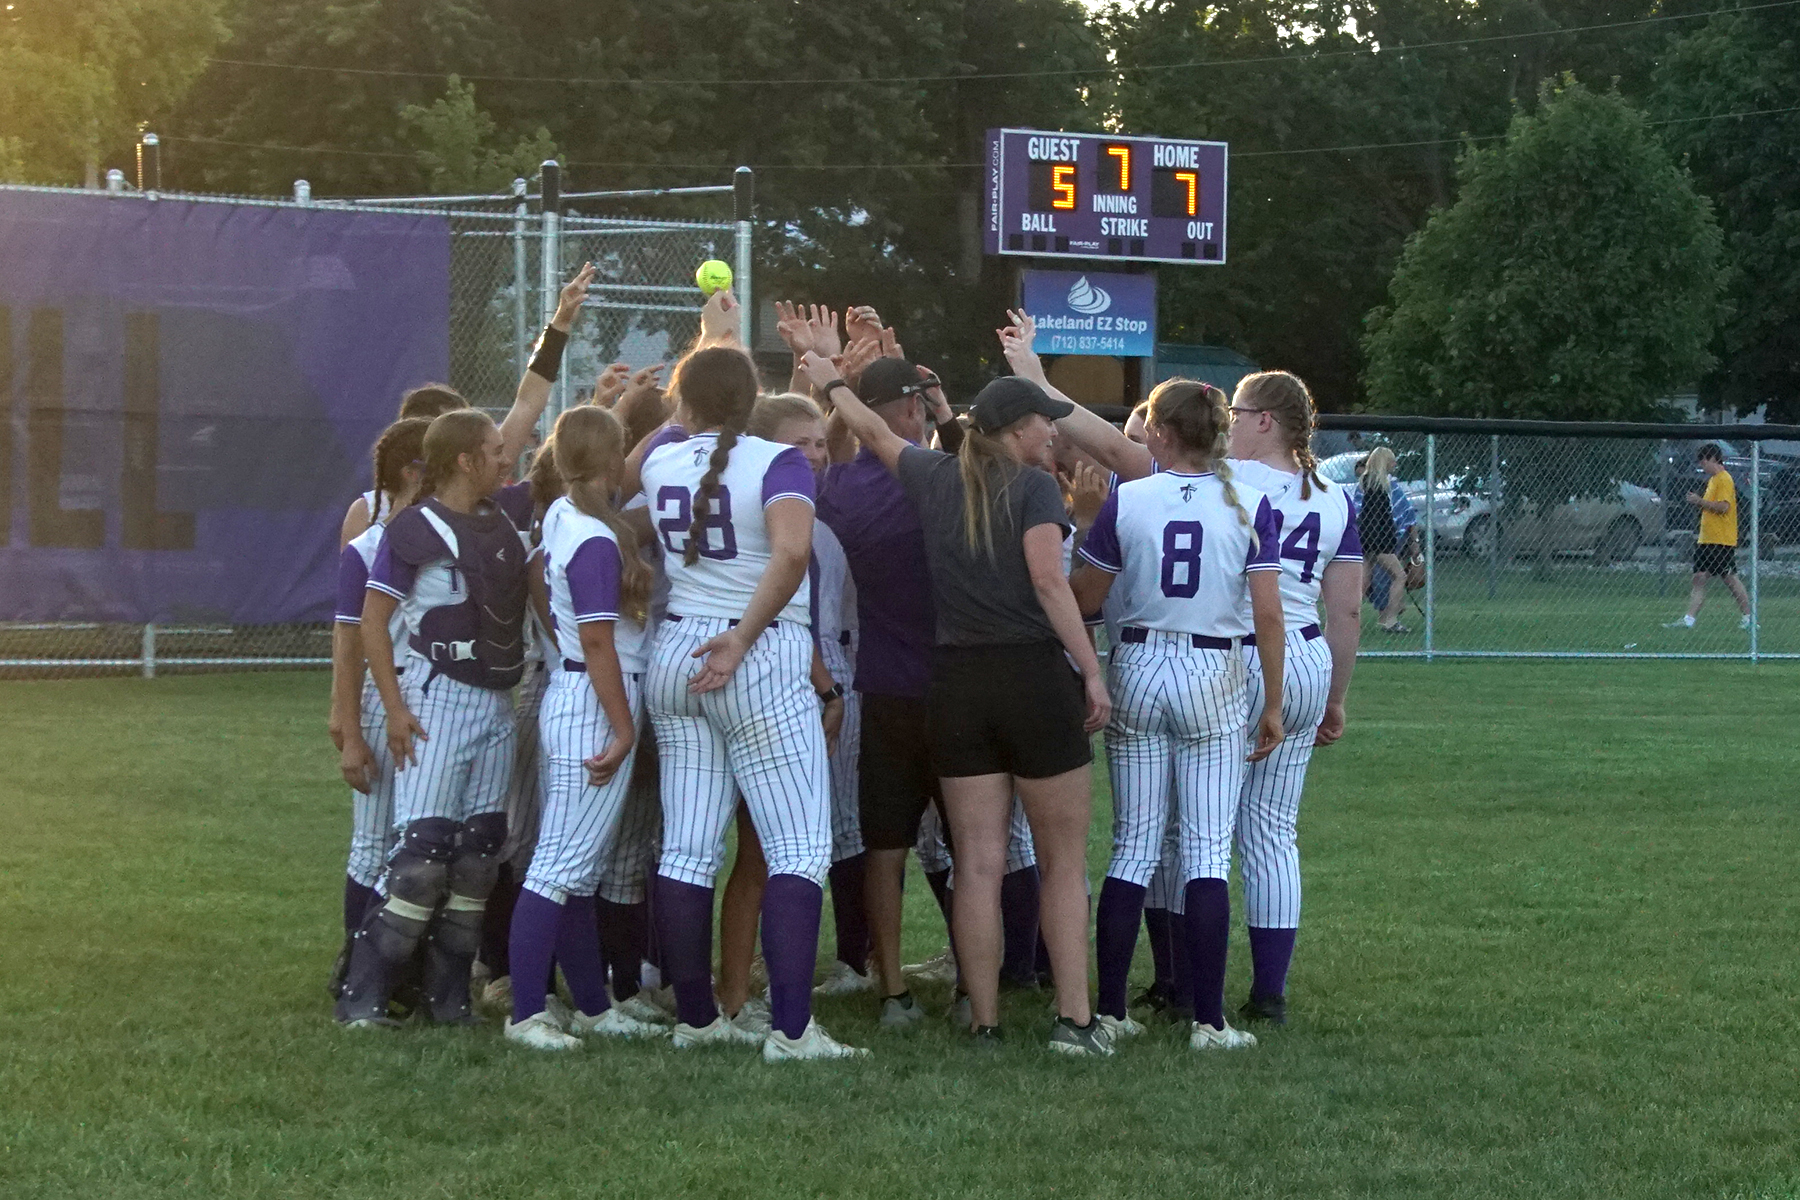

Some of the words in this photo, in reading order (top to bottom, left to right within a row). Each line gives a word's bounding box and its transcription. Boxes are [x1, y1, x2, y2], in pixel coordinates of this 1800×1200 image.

[1028, 137, 1080, 162] GUEST
[1153, 145, 1199, 168] HOME
[1108, 147, 1129, 190] 7
[1053, 166, 1074, 209] 5
[1175, 172, 1196, 215] 7
[1093, 195, 1137, 214] INNING
[1022, 214, 1056, 232] BALL
[1101, 217, 1148, 237] STRIKE
[1187, 222, 1213, 240] OUT
[1033, 314, 1093, 331] Lakeland
[1097, 316, 1113, 331] EZ
[1115, 317, 1147, 335] Stop
[1051, 335, 1077, 352] (712)
[1079, 336, 1125, 351] 837-5414
[0, 306, 196, 551] LL
[657, 484, 739, 560] 28
[1160, 520, 1203, 598] 8
